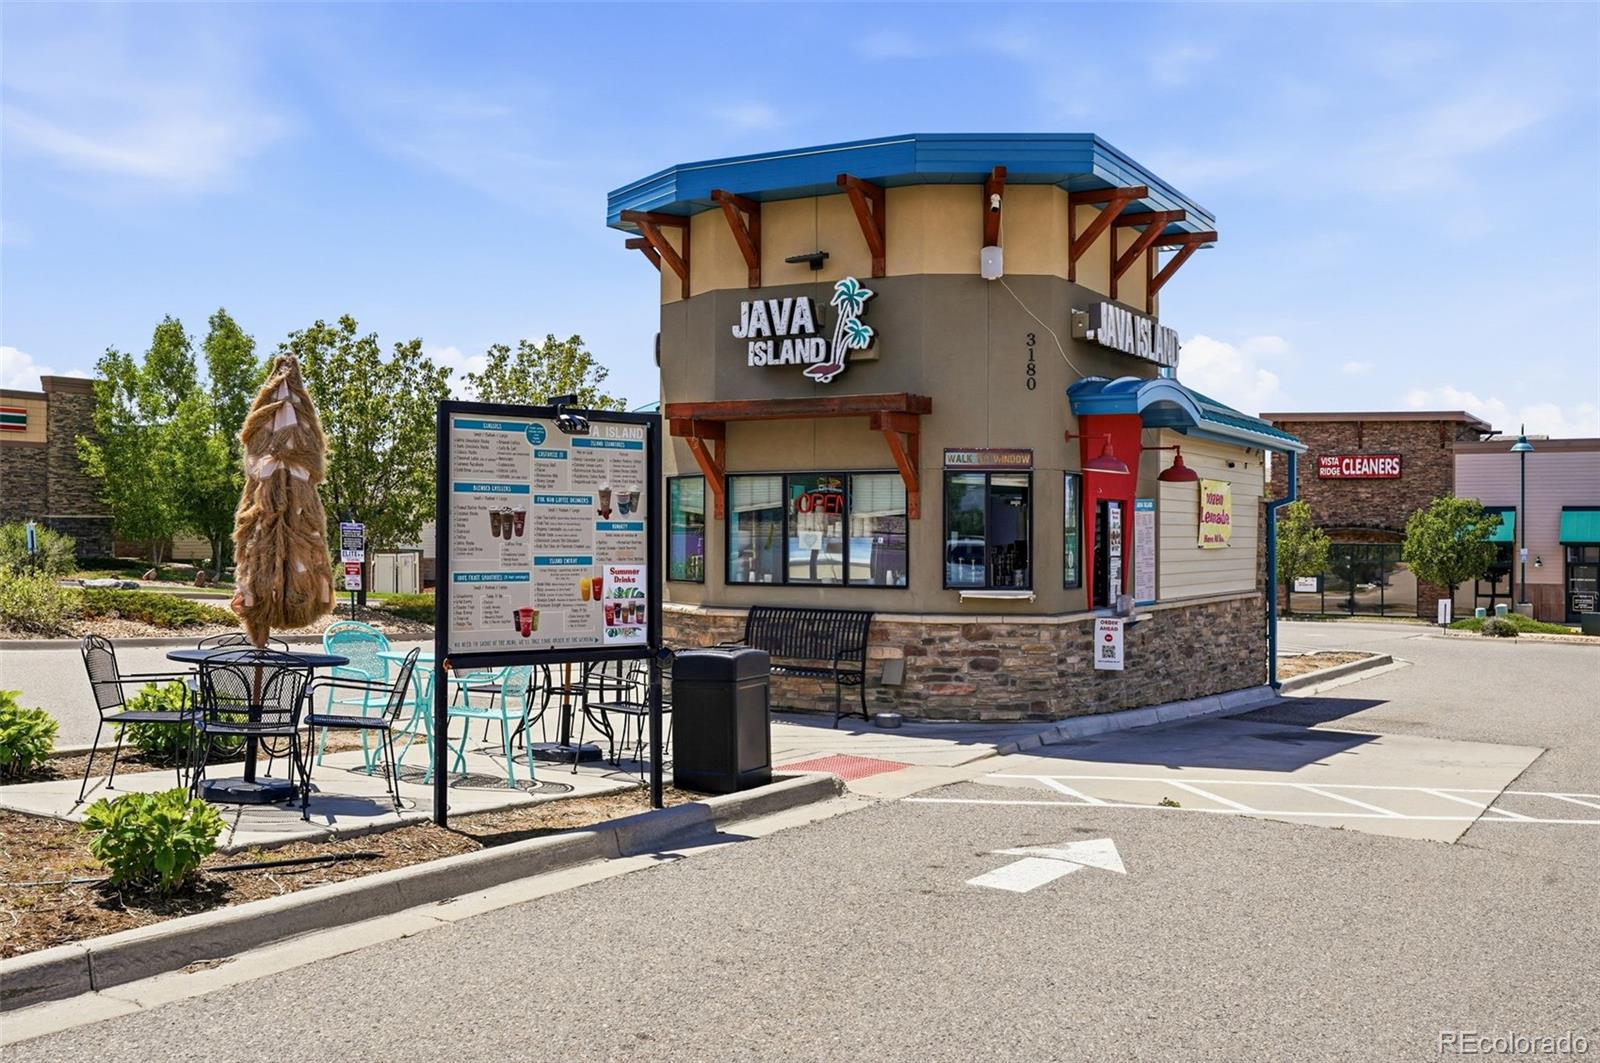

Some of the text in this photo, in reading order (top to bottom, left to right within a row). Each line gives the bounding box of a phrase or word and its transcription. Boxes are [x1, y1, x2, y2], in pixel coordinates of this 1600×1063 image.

[732, 296, 815, 339] JAVA
[1097, 301, 1180, 369] JAVA ISLAND
[747, 336, 828, 367] ISLAND
[1025, 332, 1037, 391] 3180
[605, 426, 644, 439] ISLAND
[946, 454, 973, 464] WALK
[992, 454, 1030, 464] WINDOW
[1320, 457, 1400, 475] VISTA CLEANERS
[1319, 467, 1341, 475] RIDGE
[609, 566, 640, 576] Summer
[613, 576, 636, 584] Drinks
